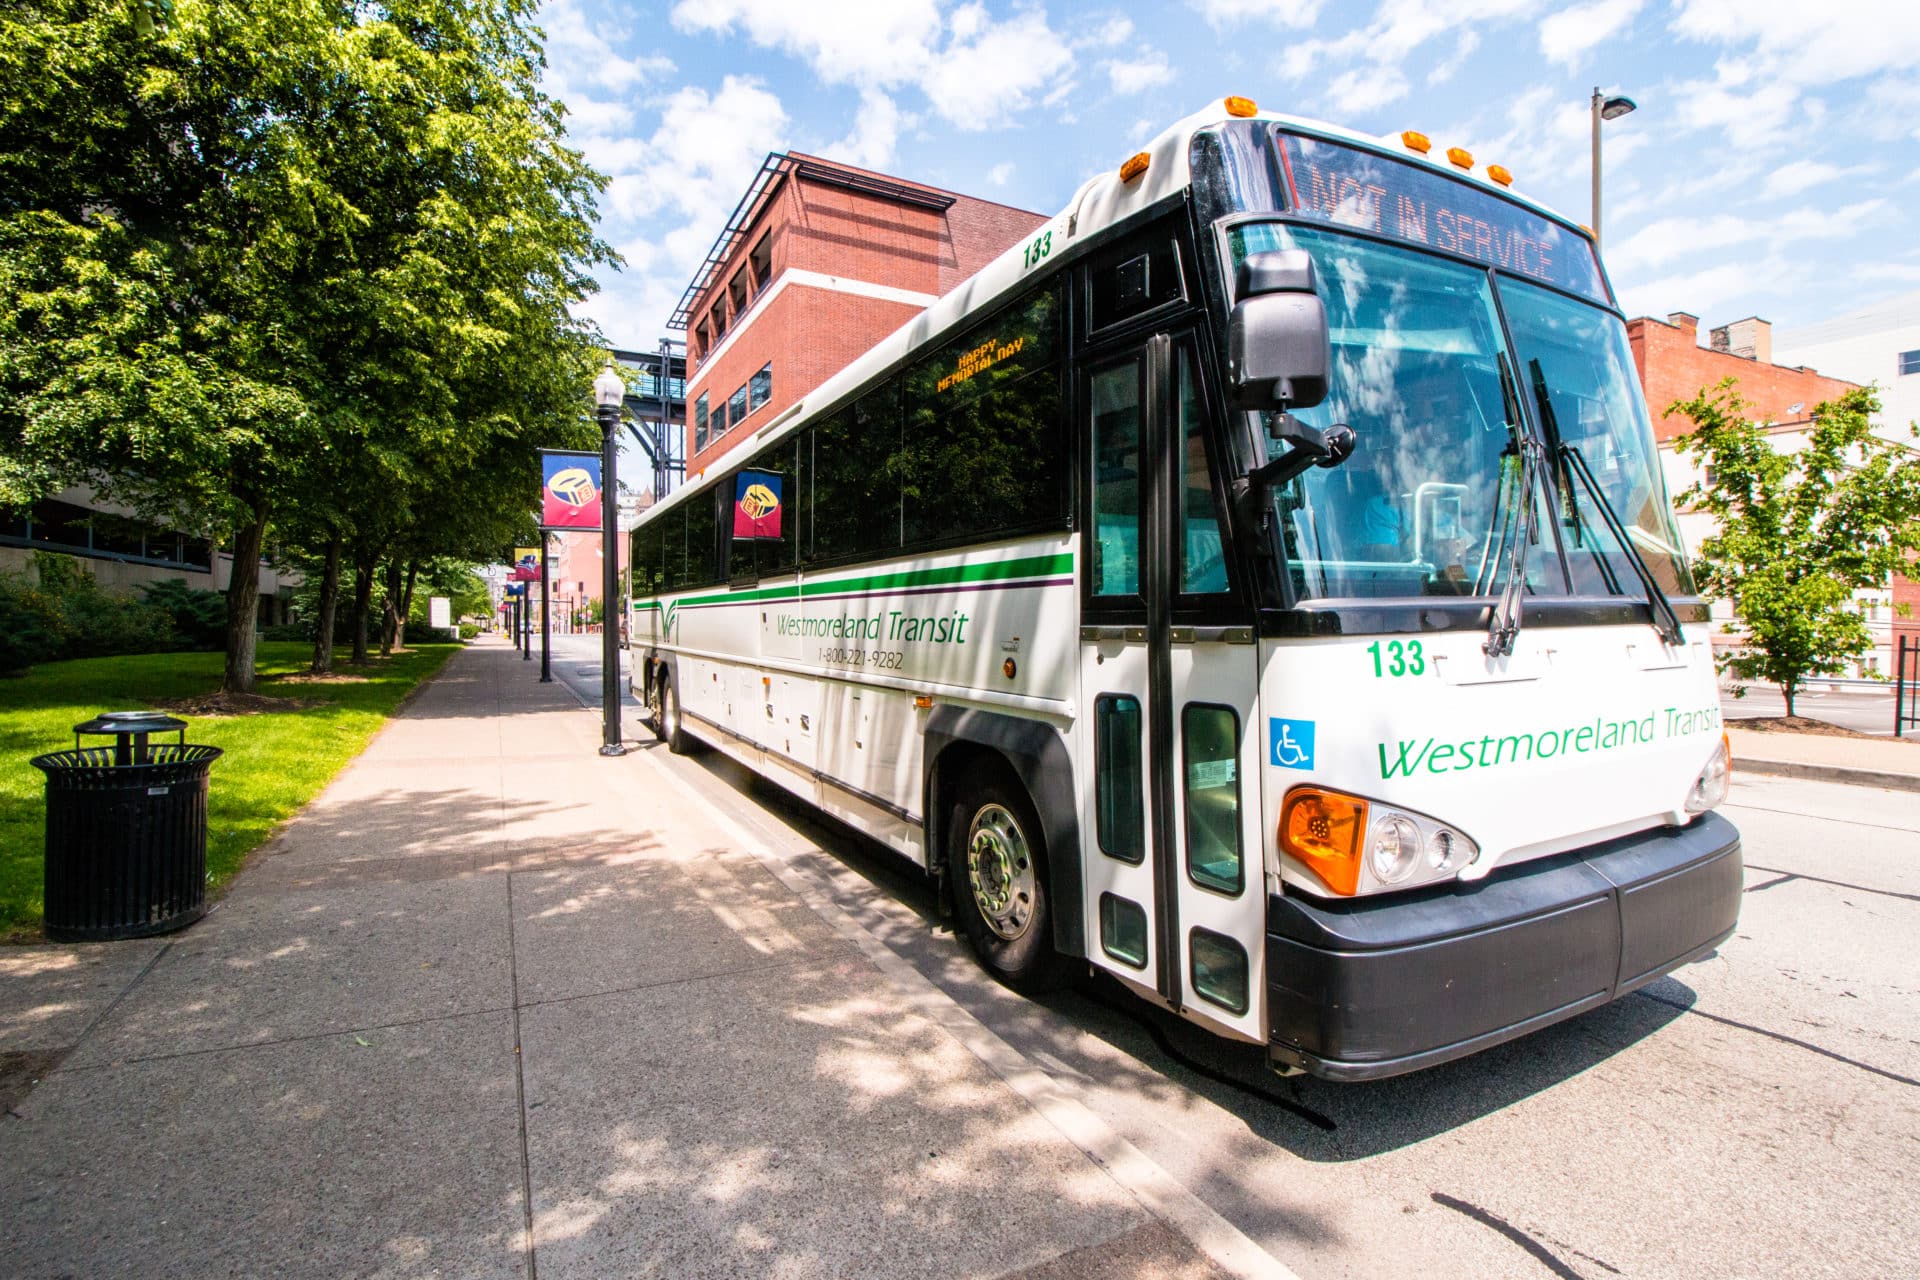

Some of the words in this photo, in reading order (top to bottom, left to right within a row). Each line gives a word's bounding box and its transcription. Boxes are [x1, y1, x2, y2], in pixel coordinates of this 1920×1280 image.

[1311, 165, 1387, 233] NOT
[1398, 194, 1428, 246] IN
[1436, 208, 1555, 283] SERVICE
[1024, 230, 1053, 269] 133
[958, 338, 997, 369] HAPPY
[777, 612, 882, 640] Westmoreland
[889, 609, 969, 644] Transit
[818, 648, 904, 670] 1-800-221-9282
[1367, 640, 1425, 678] 133
[1378, 710, 1655, 780] Westmoreland
[1664, 703, 1720, 738] Transit
